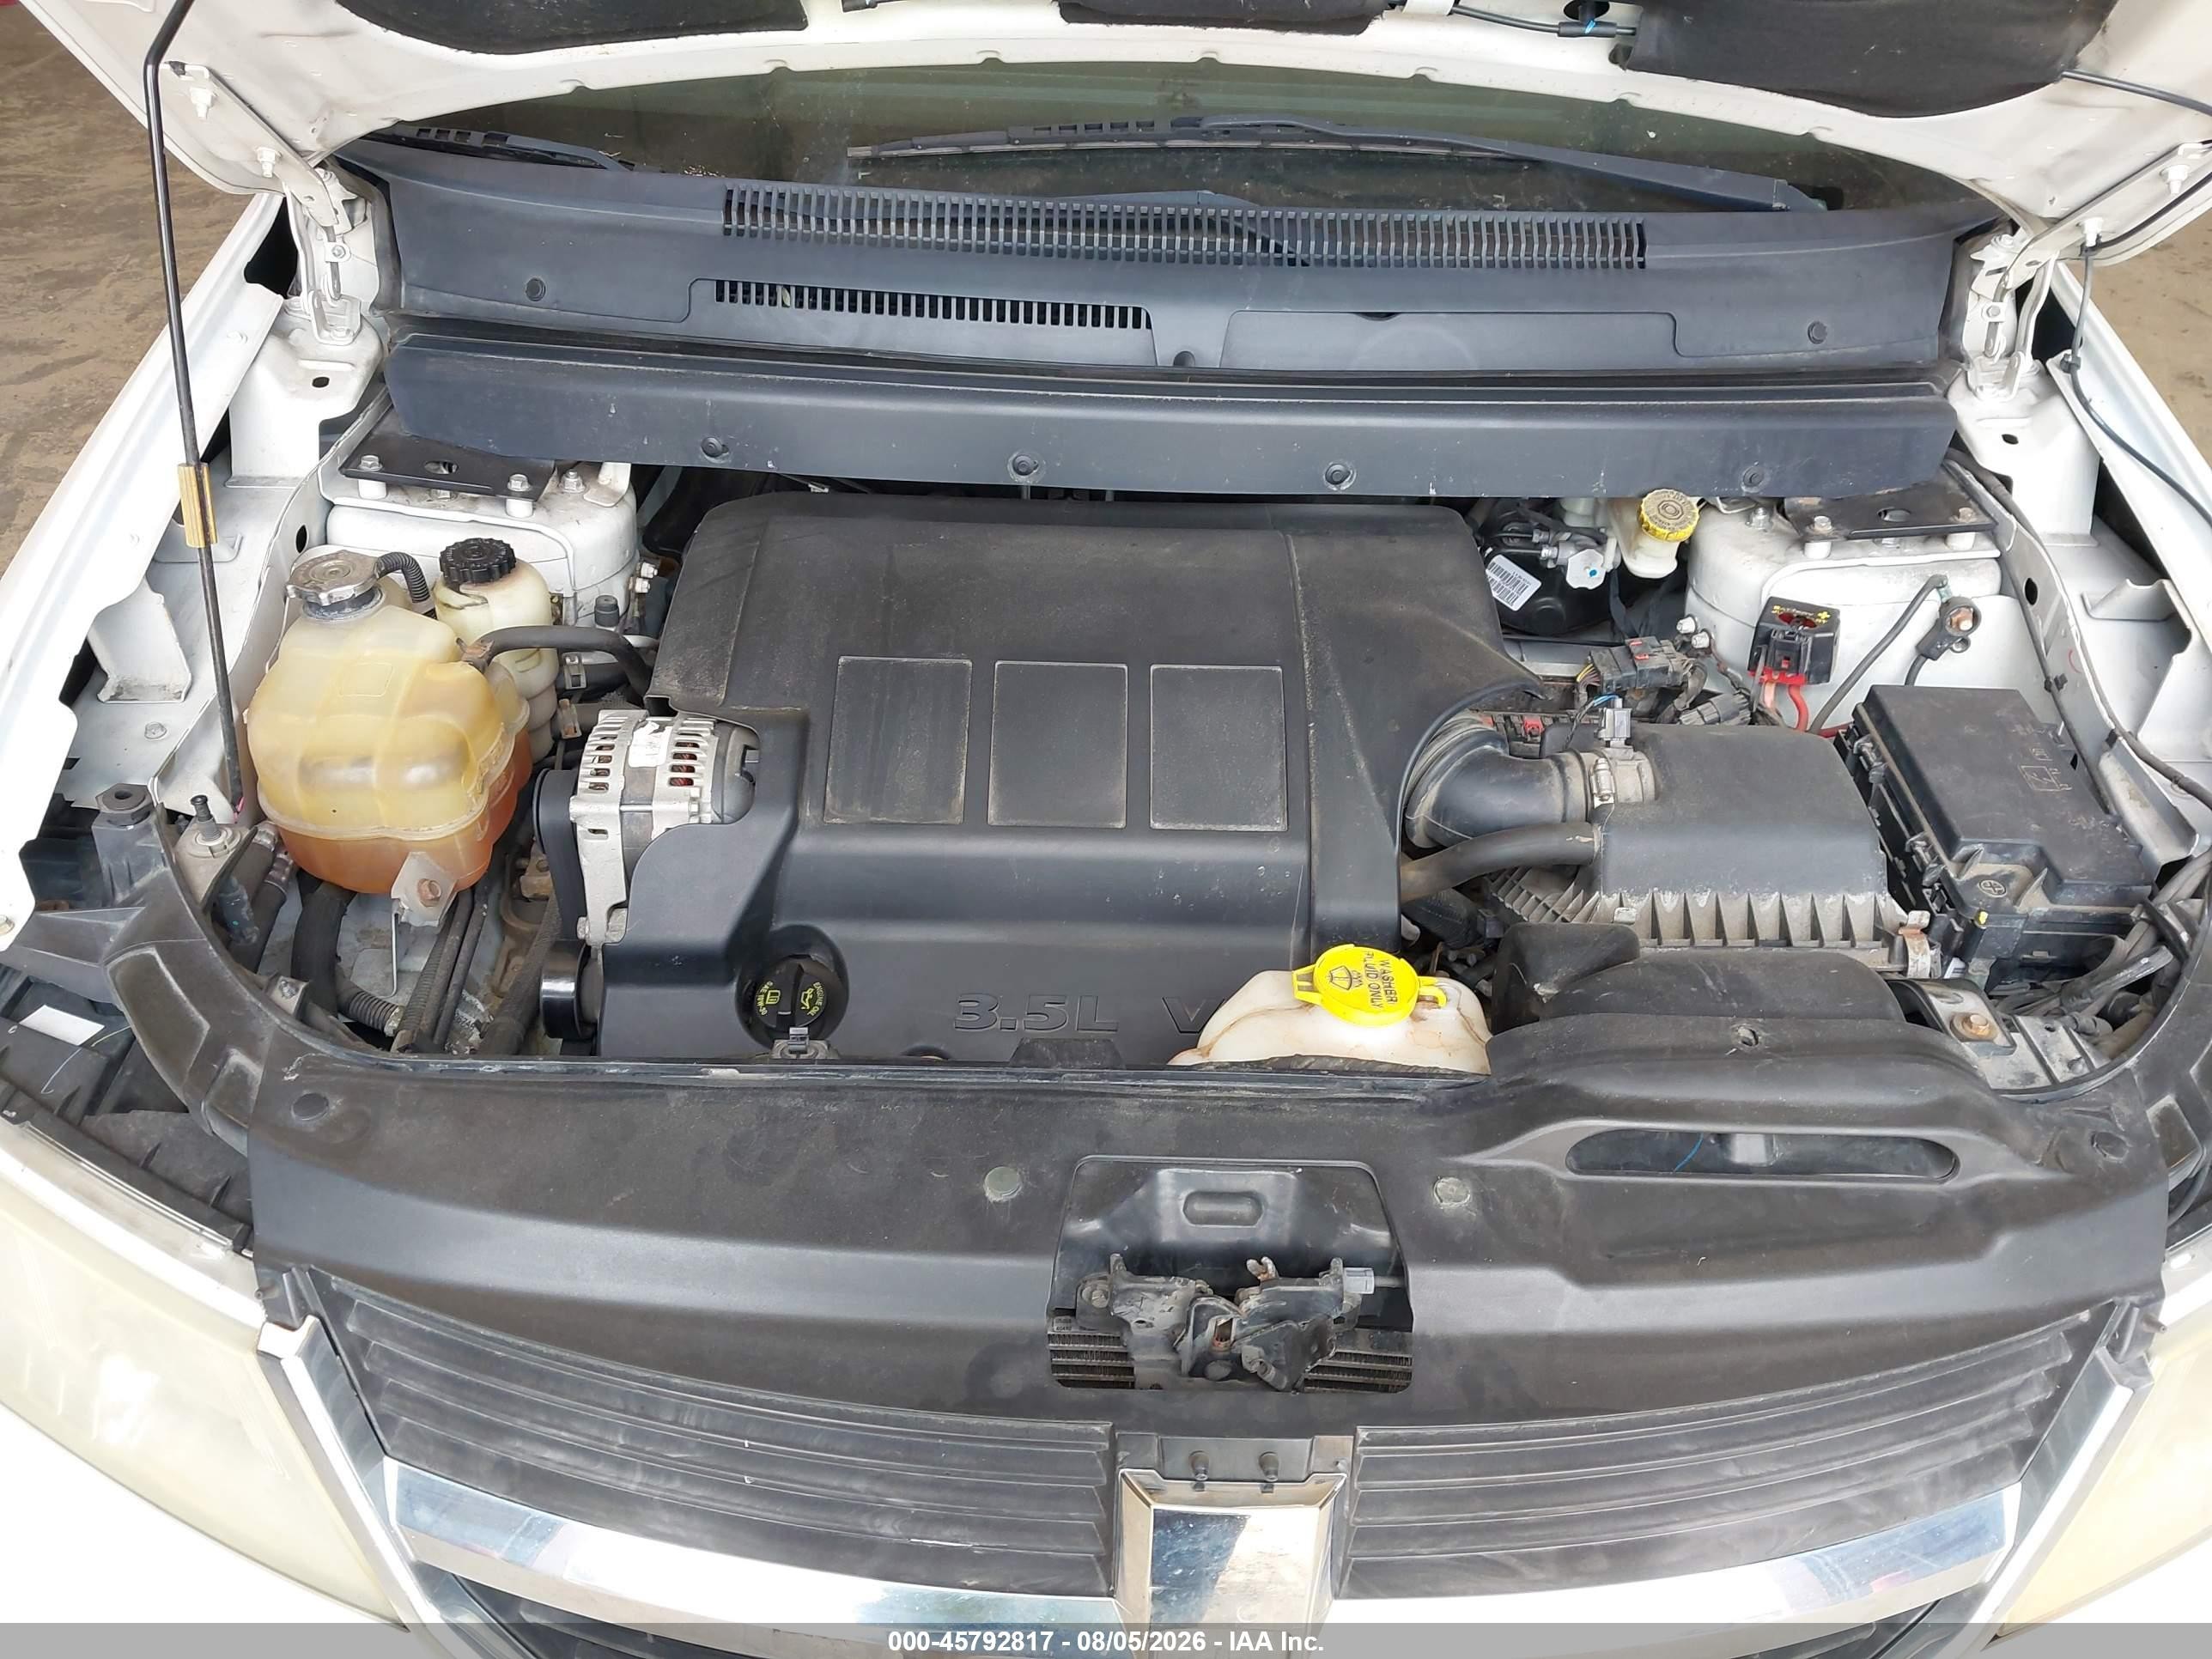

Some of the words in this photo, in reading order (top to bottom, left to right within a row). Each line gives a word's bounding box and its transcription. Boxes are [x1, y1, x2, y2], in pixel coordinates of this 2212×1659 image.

[1364, 951, 1378, 980] FLUID
[760, 981, 773, 993] SAE
[813, 981, 824, 1006] ENGINE
[1379, 959, 1398, 1004] WASHER
[1368, 982, 1383, 1009] ONLY
[807, 1006, 819, 1016] OIL
[954, 992, 1119, 1032] 3.5L
